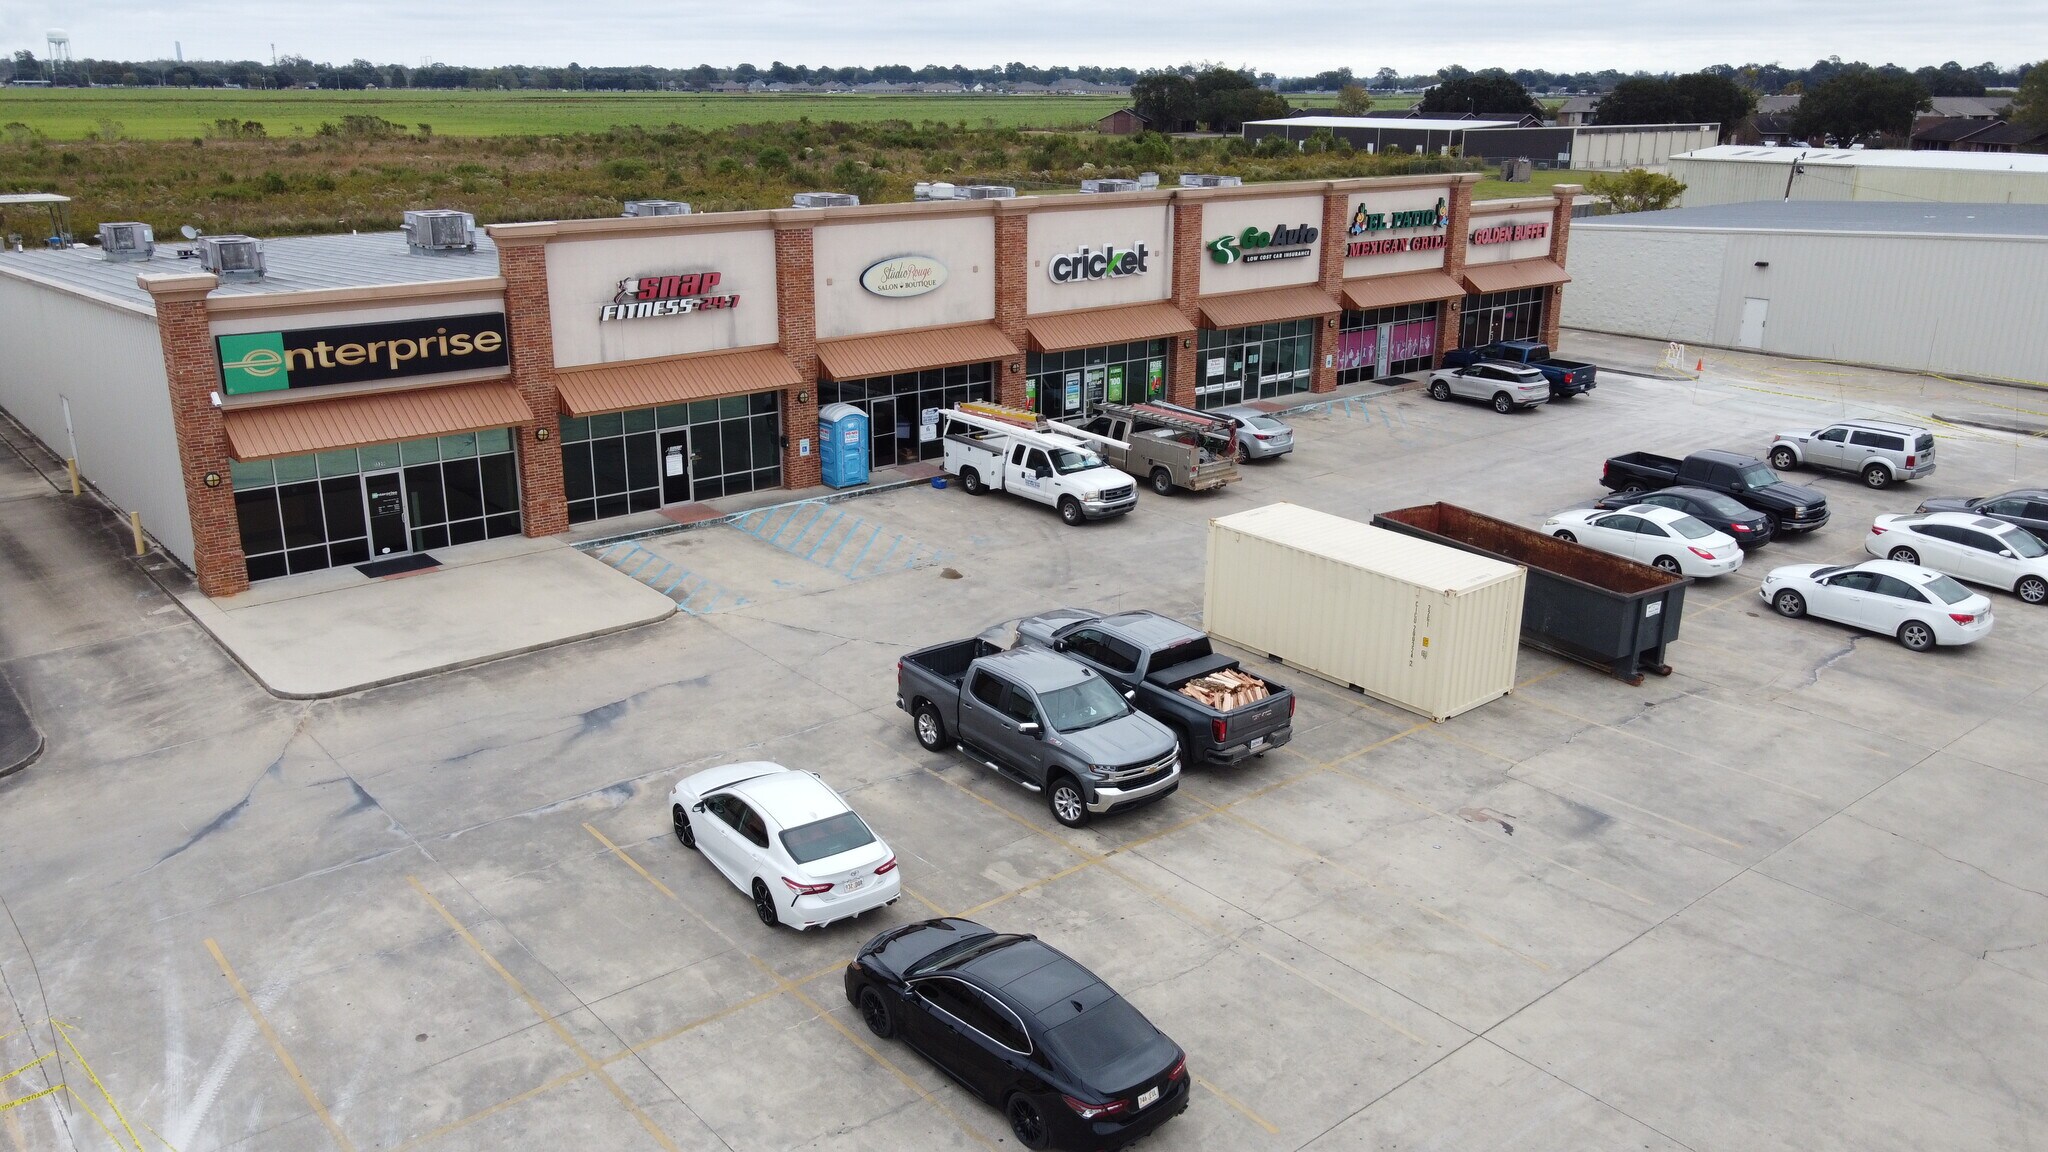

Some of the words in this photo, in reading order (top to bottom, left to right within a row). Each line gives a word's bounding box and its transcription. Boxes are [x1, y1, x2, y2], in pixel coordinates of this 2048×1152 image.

[1366, 213, 1387, 231] EL
[1391, 209, 1436, 229] PATIO
[1474, 226, 1513, 245] GOLDEN
[1514, 222, 1549, 241] BUFFET
[1284, 250, 1310, 258] INSURANCE
[1346, 238, 1409, 257] MEXICAN
[1410, 234, 1447, 251] GRILL
[1053, 243, 1149, 281] cricket
[877, 283, 899, 296] SALON
[905, 279, 936, 294] BOUTIQUE
[601, 298, 694, 322] FITNESS
[222, 327, 502, 377] enterprise
[1150, 360, 1162, 369] FREE
